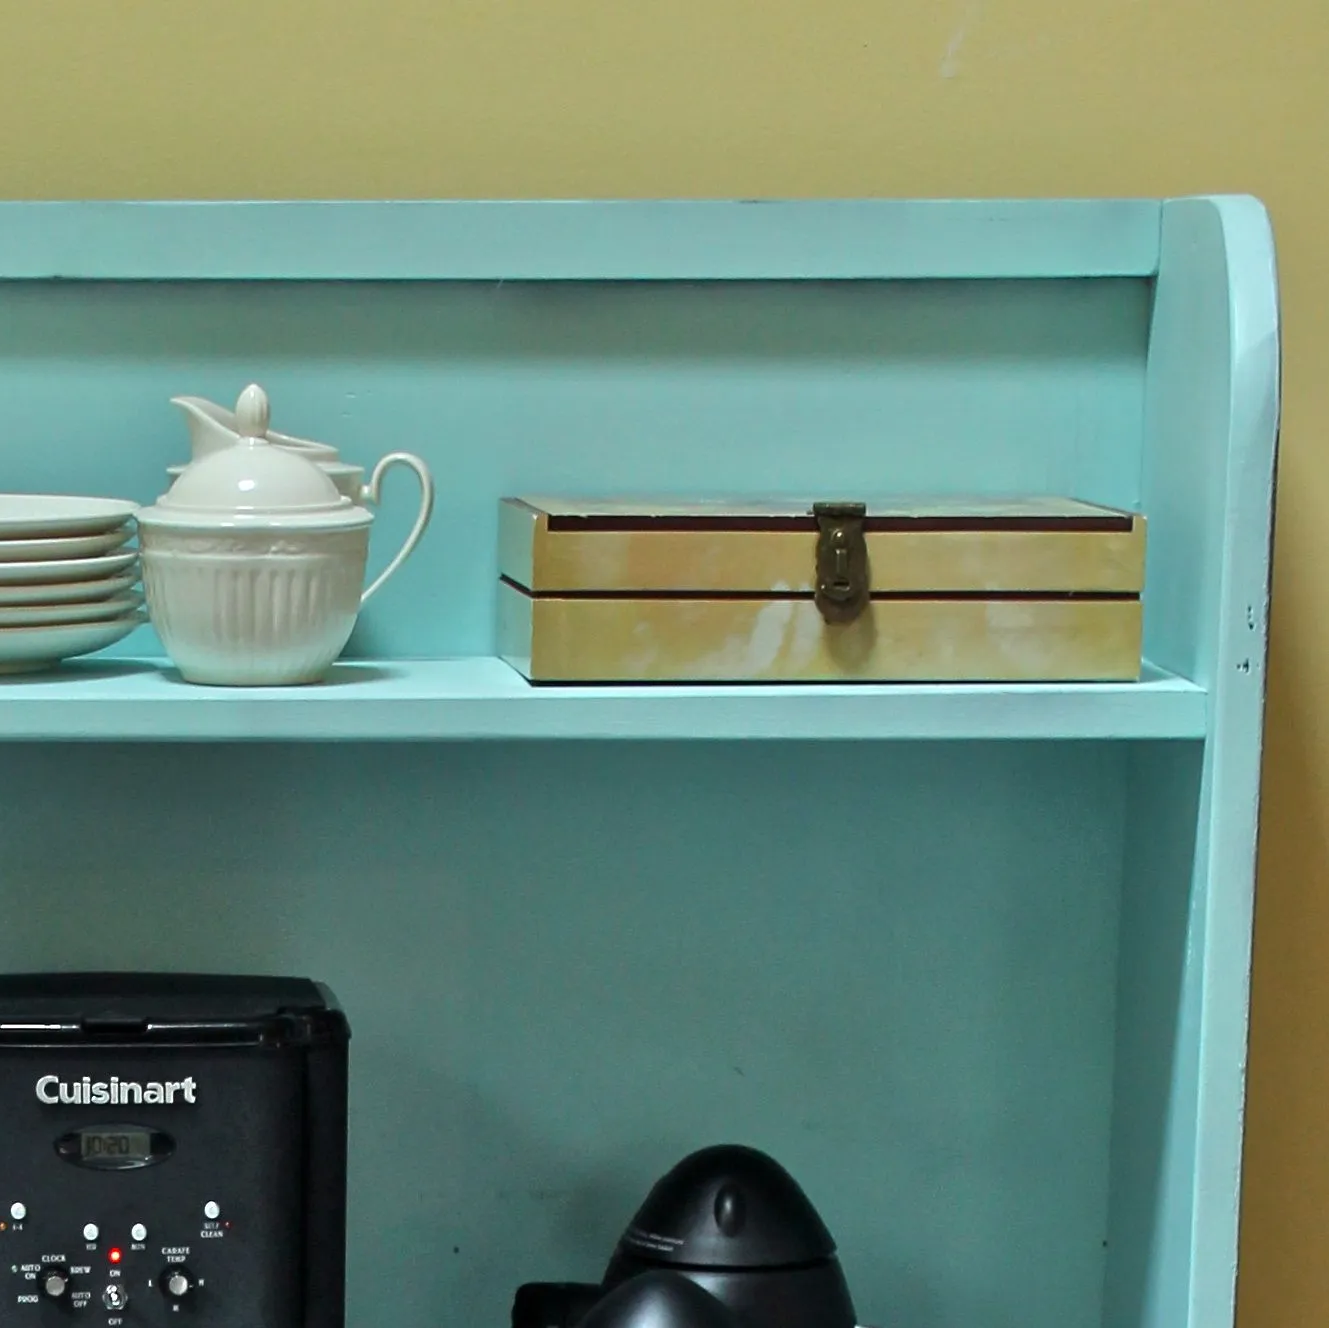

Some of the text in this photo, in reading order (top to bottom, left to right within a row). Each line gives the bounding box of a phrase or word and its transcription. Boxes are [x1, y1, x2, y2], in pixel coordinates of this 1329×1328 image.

[35, 1075, 197, 1104] Cuisinart
[161, 1247, 190, 1255] CARAFE
[41, 1254, 66, 1263] CLOCK
[20, 1264, 41, 1272] AUTO
[70, 1266, 91, 1274] BREW
[24, 1272, 37, 1280] ON
[109, 1269, 121, 1277] ON
[71, 1291, 91, 1299] AUTO
[73, 1300, 87, 1308] OFF
[108, 1317, 123, 1326] OFF
